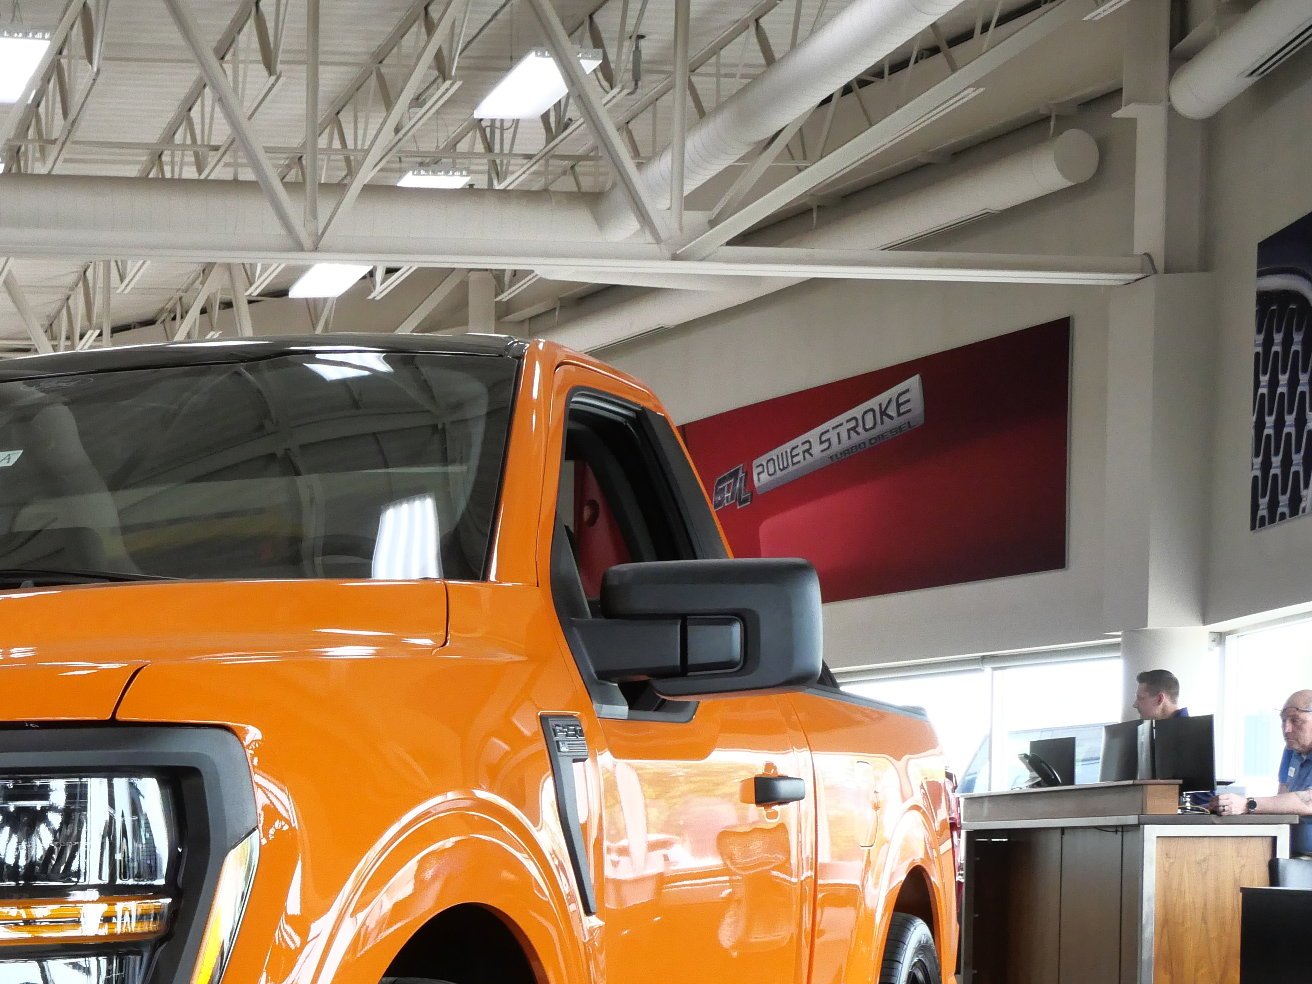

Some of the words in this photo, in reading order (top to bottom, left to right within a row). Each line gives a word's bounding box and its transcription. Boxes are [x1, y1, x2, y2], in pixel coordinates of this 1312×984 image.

[755, 440, 814, 483] POWER
[819, 388, 912, 453] STROKE
[827, 442, 866, 463] TURBO
[869, 421, 917, 446] DIESEL
